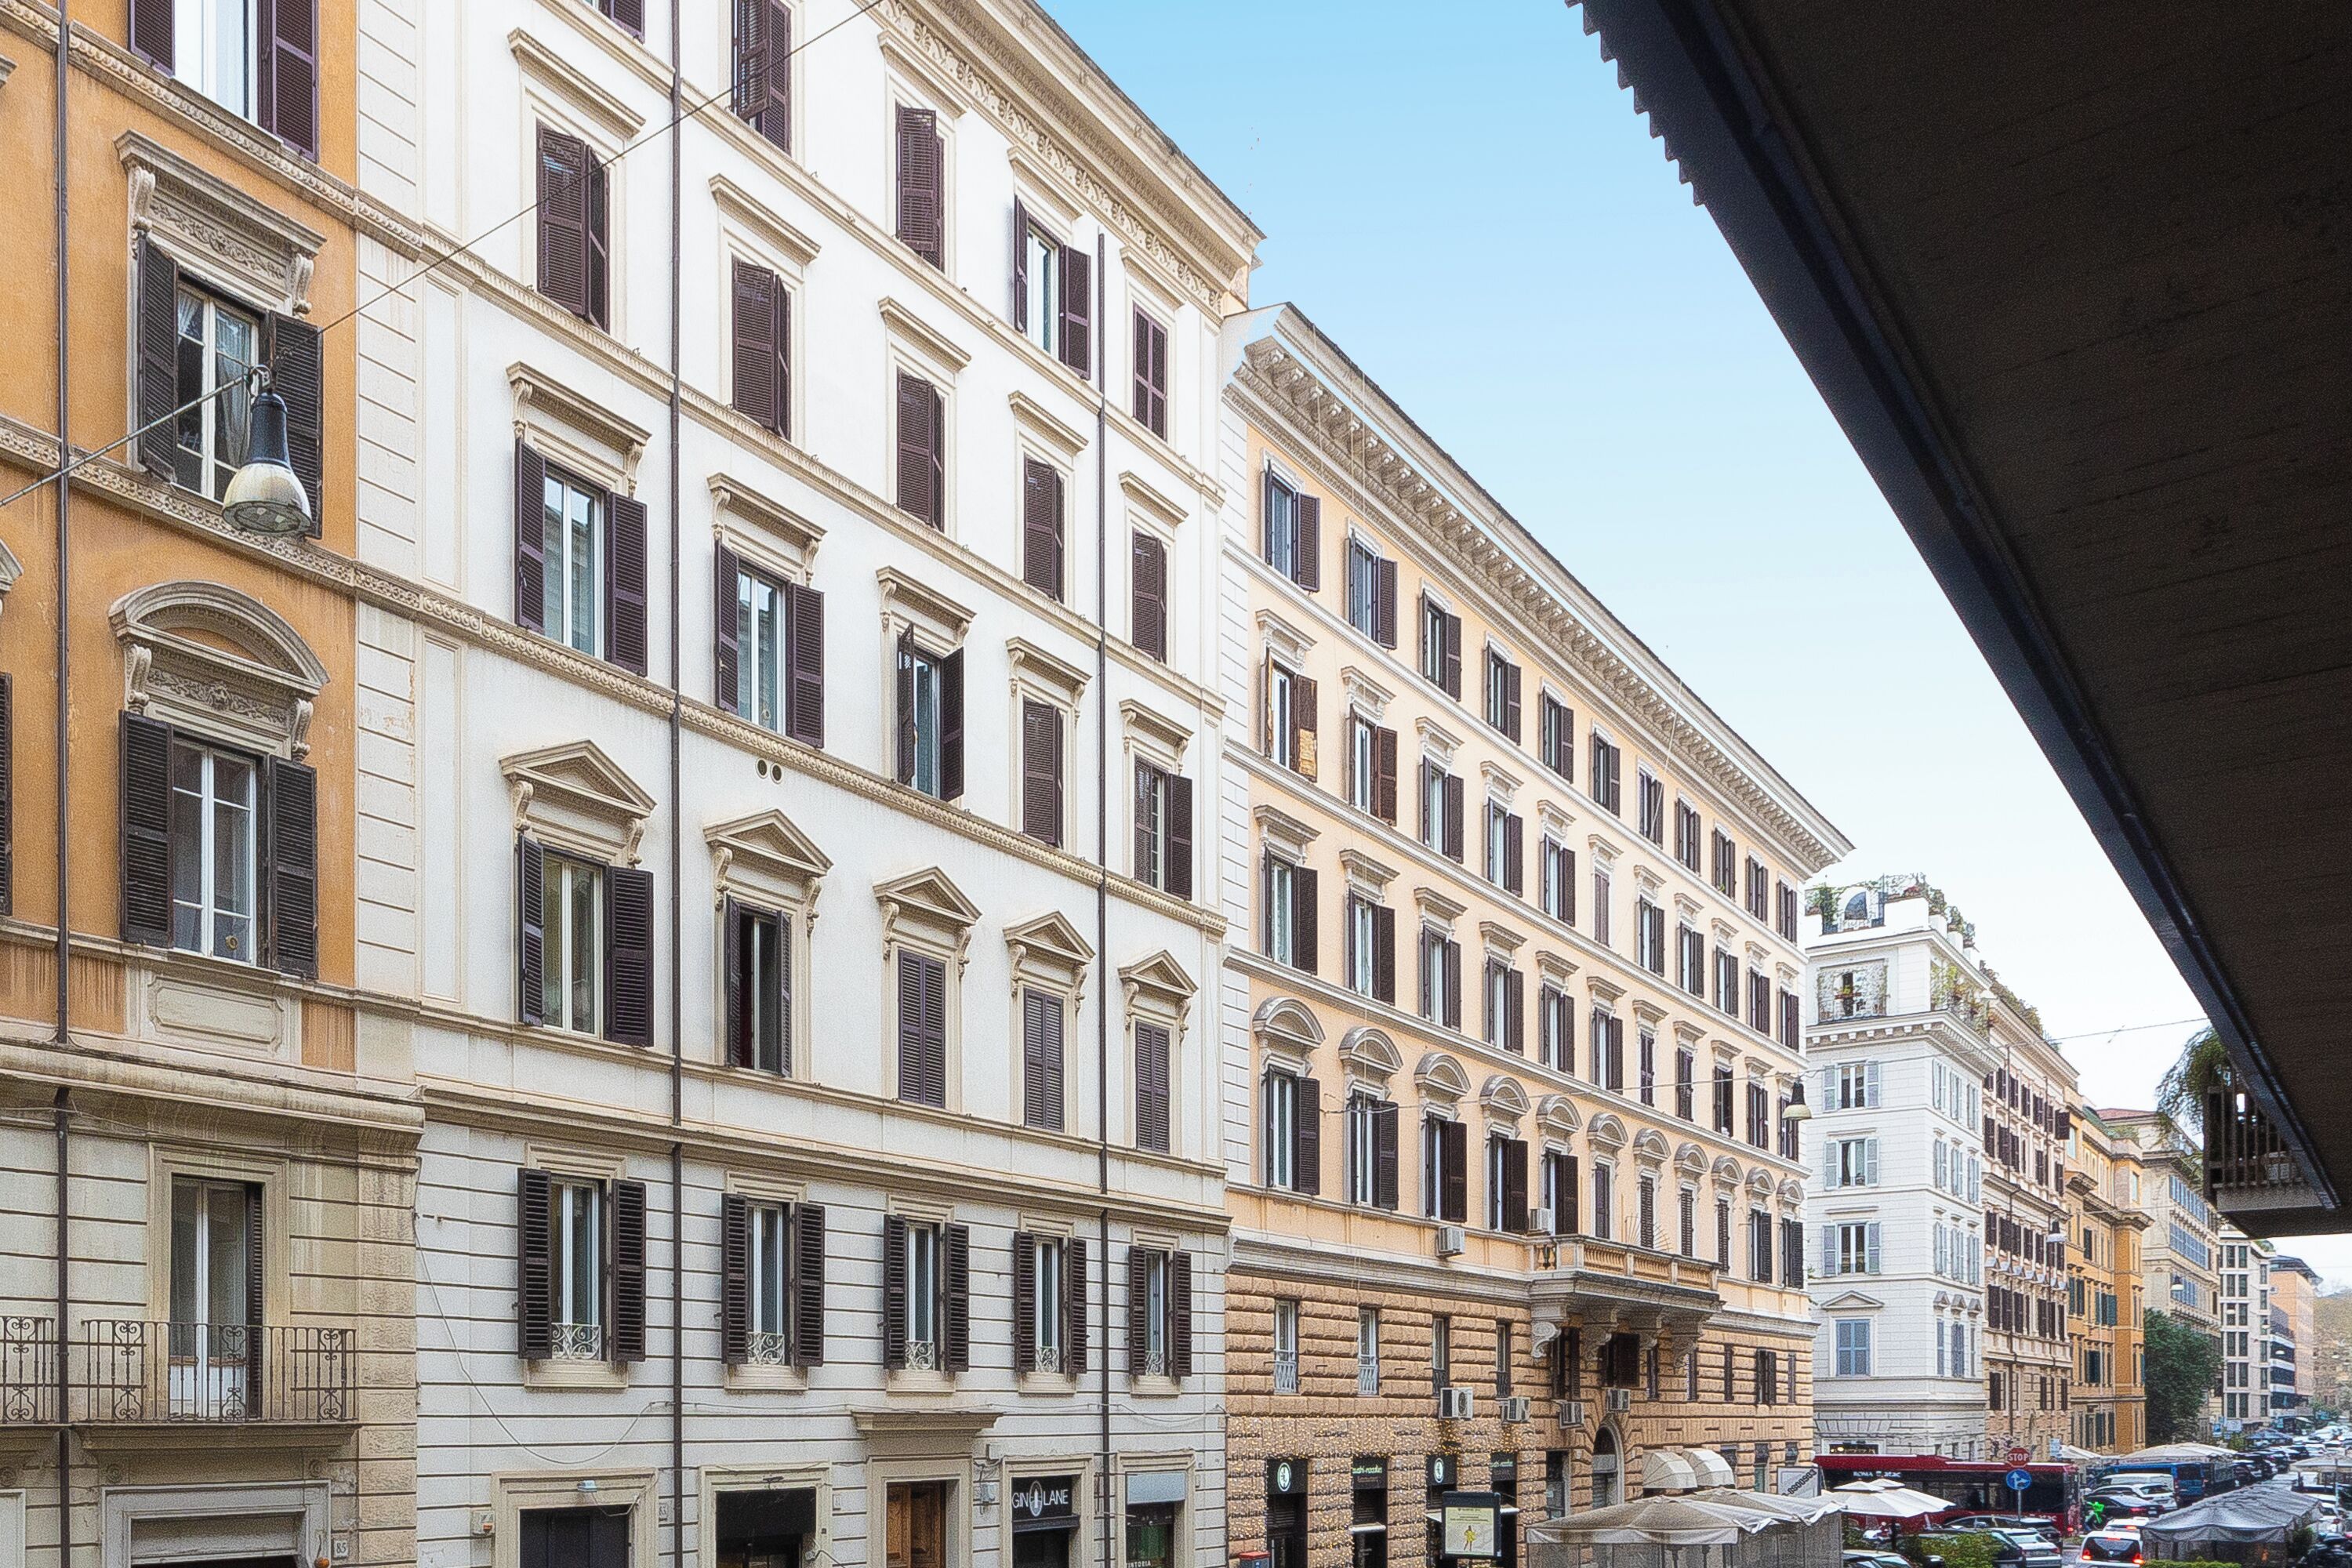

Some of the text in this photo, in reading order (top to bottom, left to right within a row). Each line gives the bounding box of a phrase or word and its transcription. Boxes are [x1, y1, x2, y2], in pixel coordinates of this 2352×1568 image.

[2008, 1453, 2029, 1461] STOP
[1012, 1490, 1069, 1508] GIN LANE
[336, 1542, 347, 1554] 85
